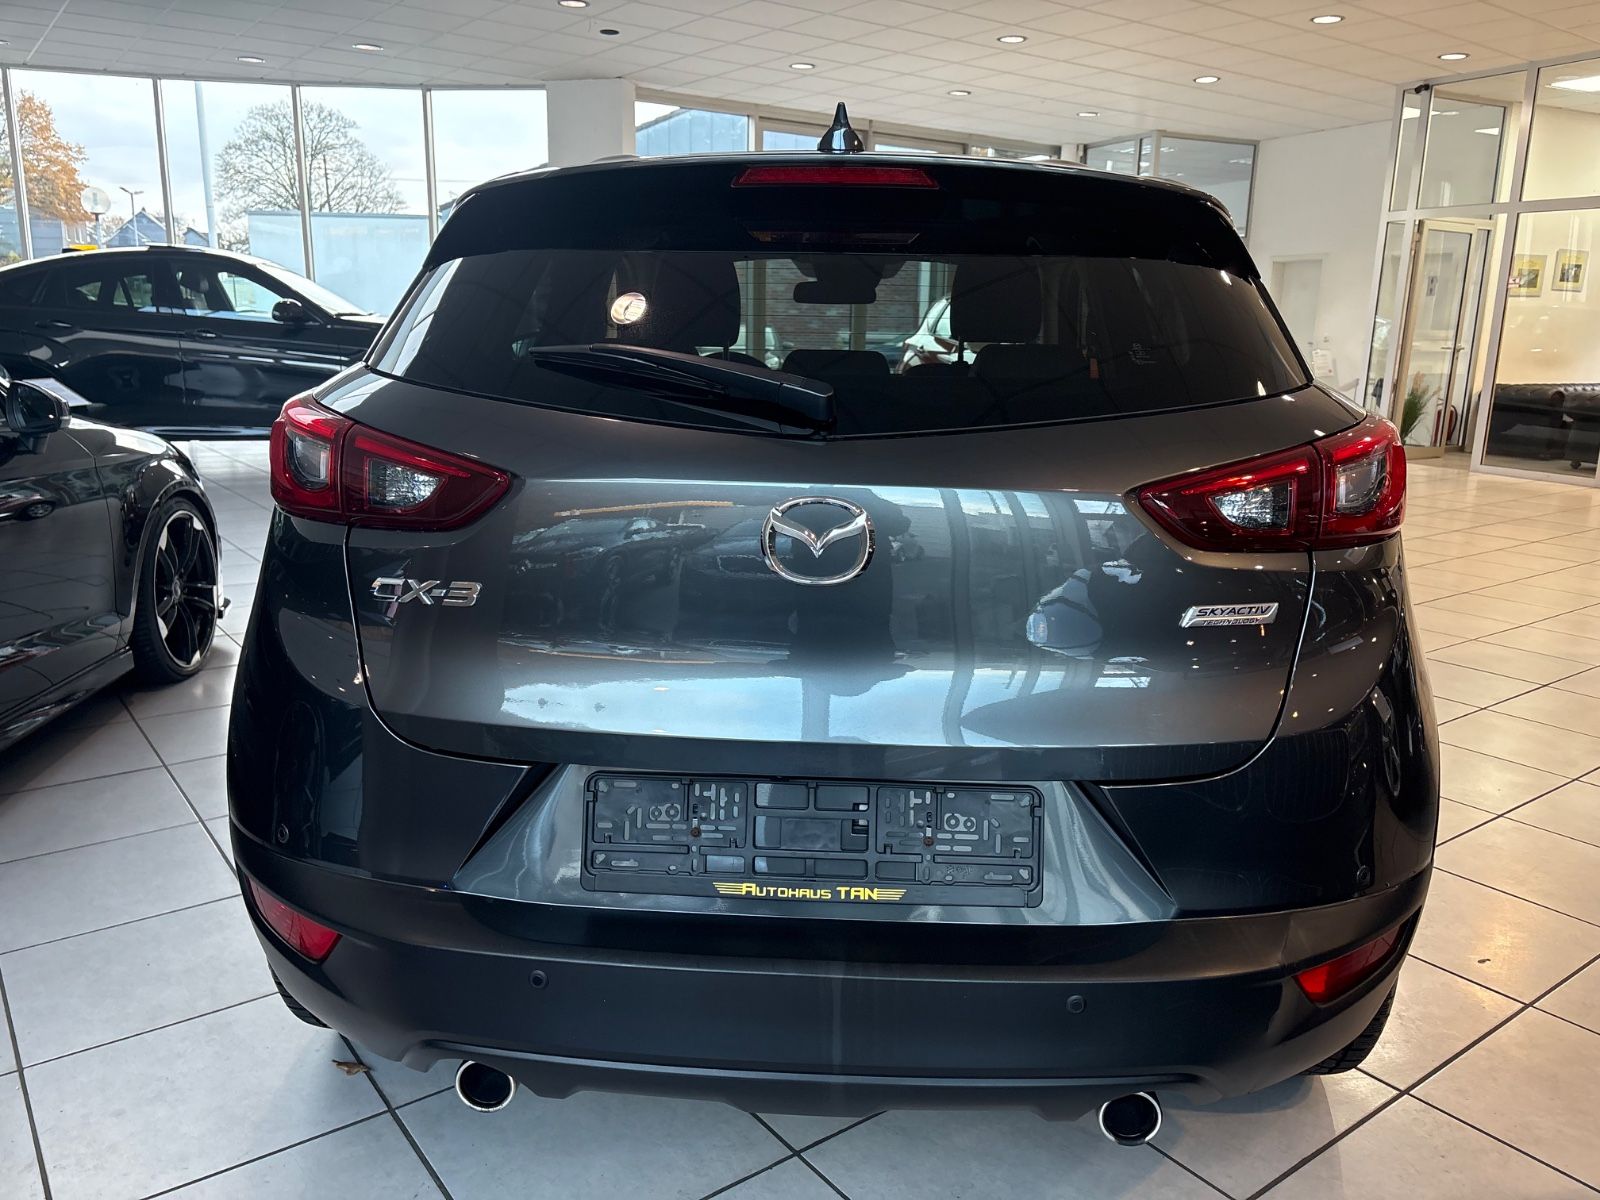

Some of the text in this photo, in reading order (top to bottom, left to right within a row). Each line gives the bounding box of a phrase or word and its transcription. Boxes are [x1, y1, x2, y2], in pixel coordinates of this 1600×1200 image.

[370, 577, 483, 607] CX-3
[1196, 605, 1271, 617] SKYACTIV
[742, 883, 878, 900] AUTOHAUS TAN
